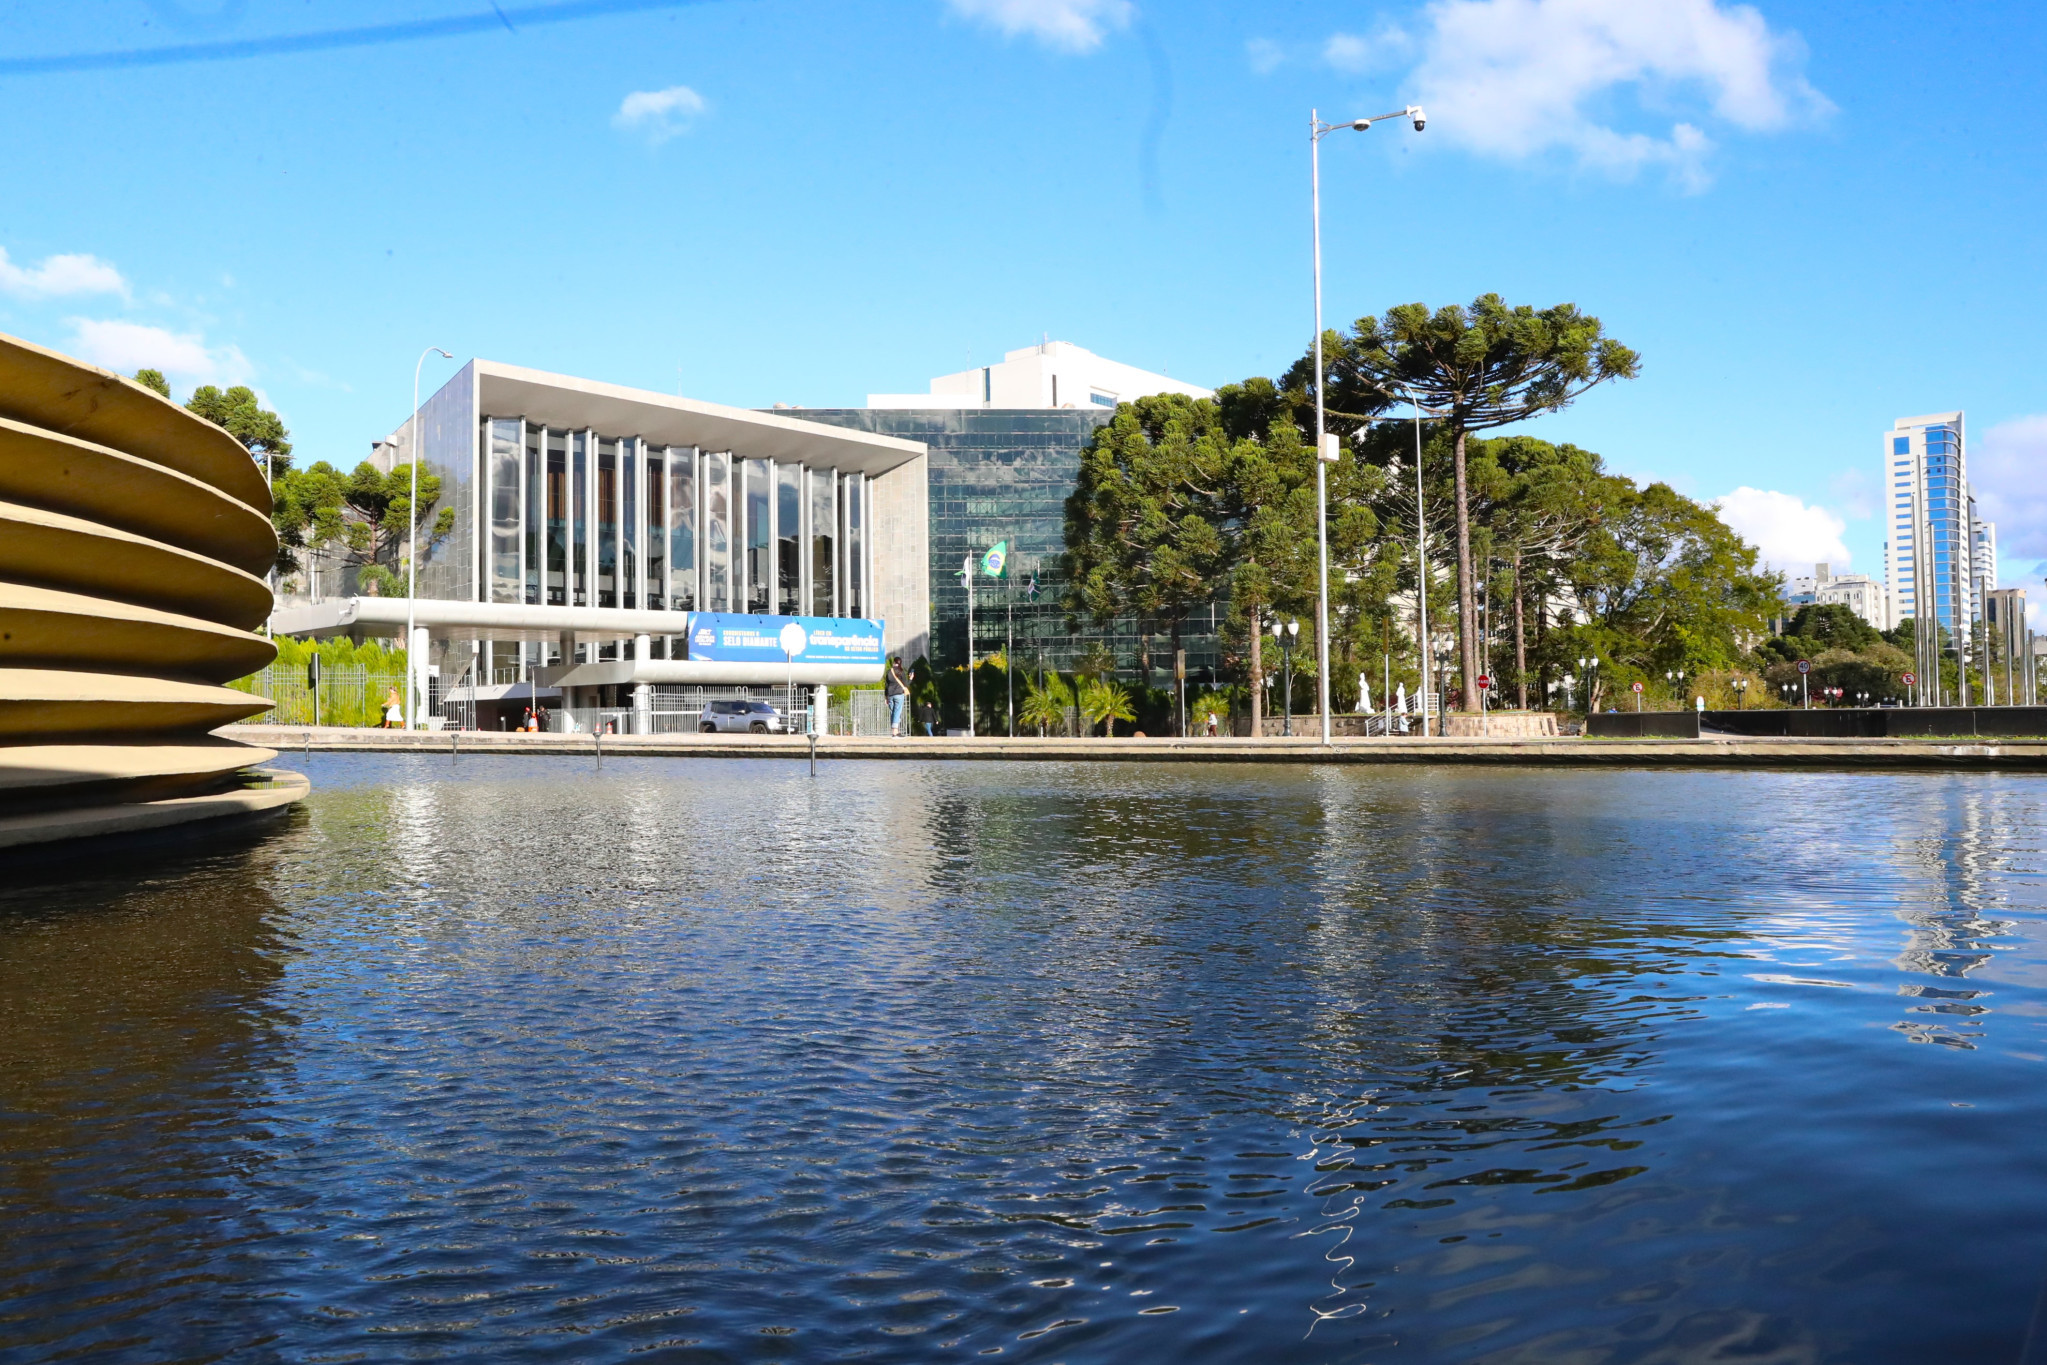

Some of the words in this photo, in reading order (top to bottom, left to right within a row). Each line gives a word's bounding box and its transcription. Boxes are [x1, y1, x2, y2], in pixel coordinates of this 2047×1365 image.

[723, 636, 741, 646] SELO
[743, 637, 778, 647] DIAMANTE
[809, 634, 878, 648] transparência
